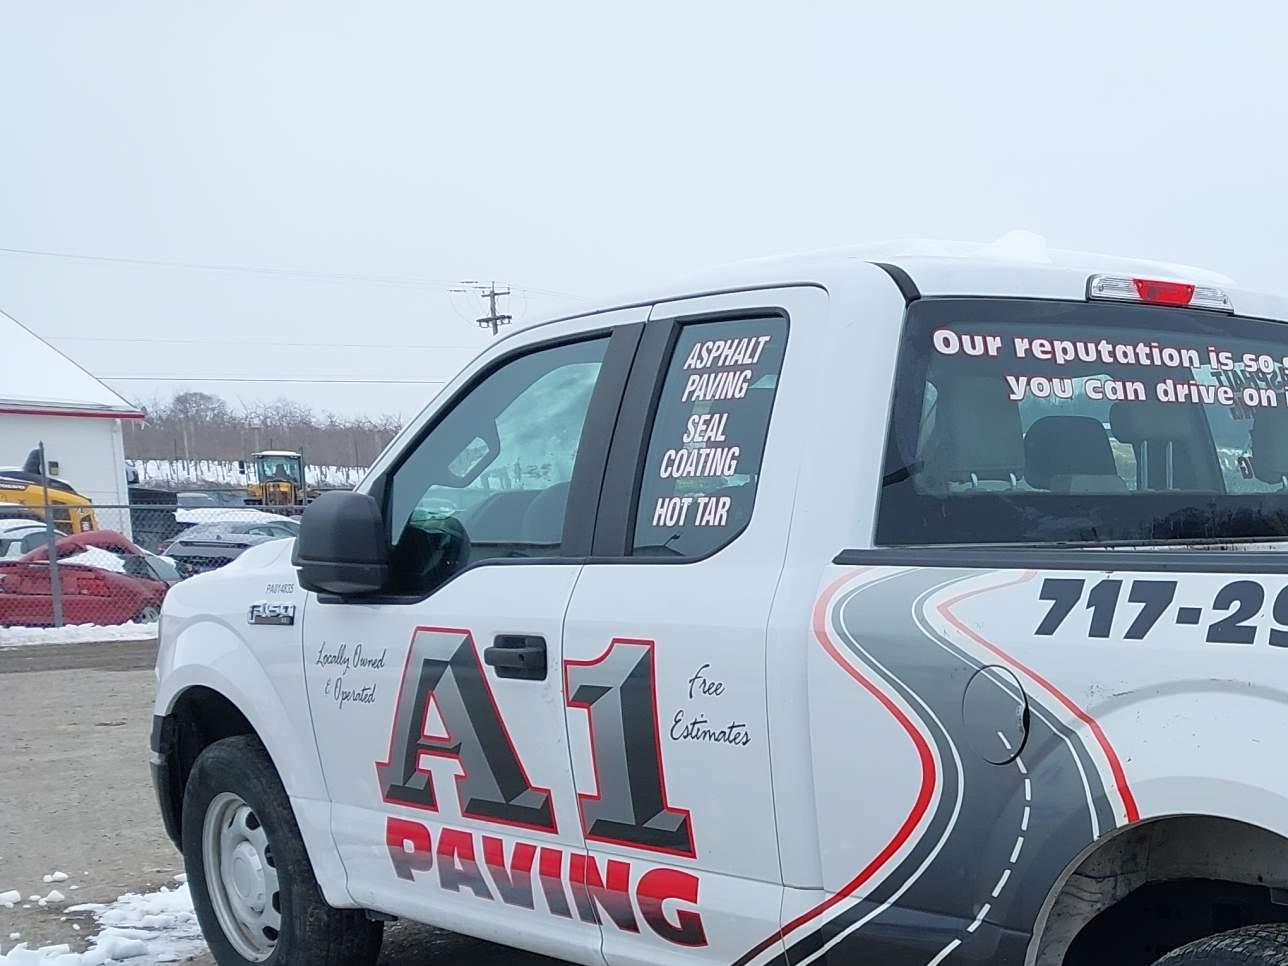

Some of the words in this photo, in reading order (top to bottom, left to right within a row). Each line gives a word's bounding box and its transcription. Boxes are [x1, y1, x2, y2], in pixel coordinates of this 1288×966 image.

[683, 336, 770, 370] ASPHALT
[933, 329, 1002, 356] Our
[1014, 337, 1200, 368] reputation
[1208, 346, 1234, 371] is
[1243, 354, 1274, 373] so
[682, 369, 752, 402] PAVING
[1006, 375, 1073, 400] you
[1085, 378, 1146, 401] can
[1156, 379, 1234, 405] drive
[1243, 387, 1277, 407] on
[683, 412, 728, 443] SEAL
[660, 446, 740, 478] COATING
[652, 497, 692, 527] HOT
[695, 496, 731, 527] TAR
[316, 641, 350, 676] Locally
[352, 643, 387, 670] Owned
[334, 677, 377, 710] Operated
[688, 663, 726, 699] Free
[375, 626, 697, 860] A1
[670, 709, 751, 746] Estimates
[385, 815, 710, 948] PAVING
